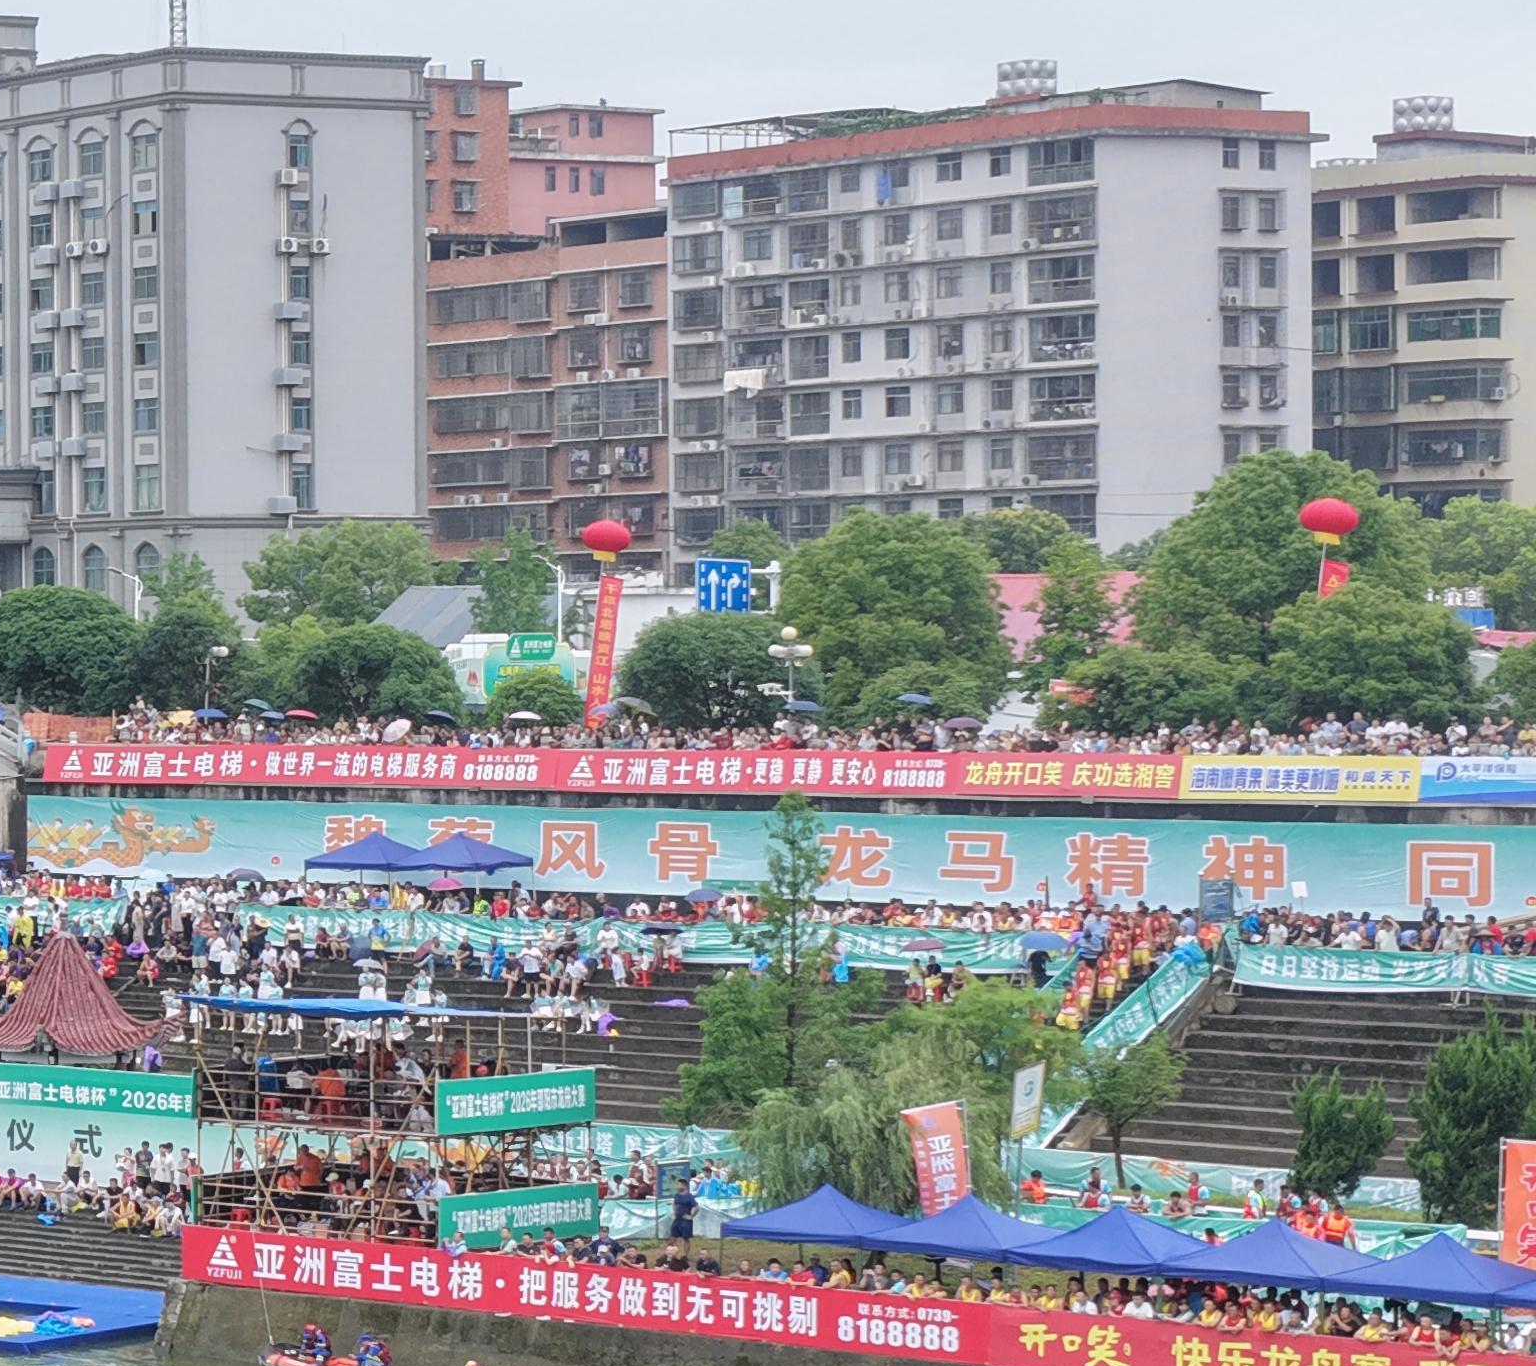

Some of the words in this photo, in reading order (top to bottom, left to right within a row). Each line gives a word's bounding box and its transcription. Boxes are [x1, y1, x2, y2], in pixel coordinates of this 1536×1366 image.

[91, 750, 458, 779] 亚洲富士电梯·做世界一流的电梯服务商
[463, 764, 538, 782] 8188888
[829, 757, 877, 785] 更安心
[964, 761, 1064, 786] 龙舟开口笑
[1072, 762, 1175, 789] 庆功选湘窖
[1345, 770, 1411, 783] 和成天下
[882, 770, 945, 788] 8188888
[820, 831, 1287, 900] 龙马精神
[1260, 955, 1380, 981] 日日坚持运动
[205, 1266, 244, 1279] YZFUJI
[253, 1241, 820, 1338] 亚洲富士电梯·把服务做到无可挑剔
[837, 1317, 960, 1353] 8188888
